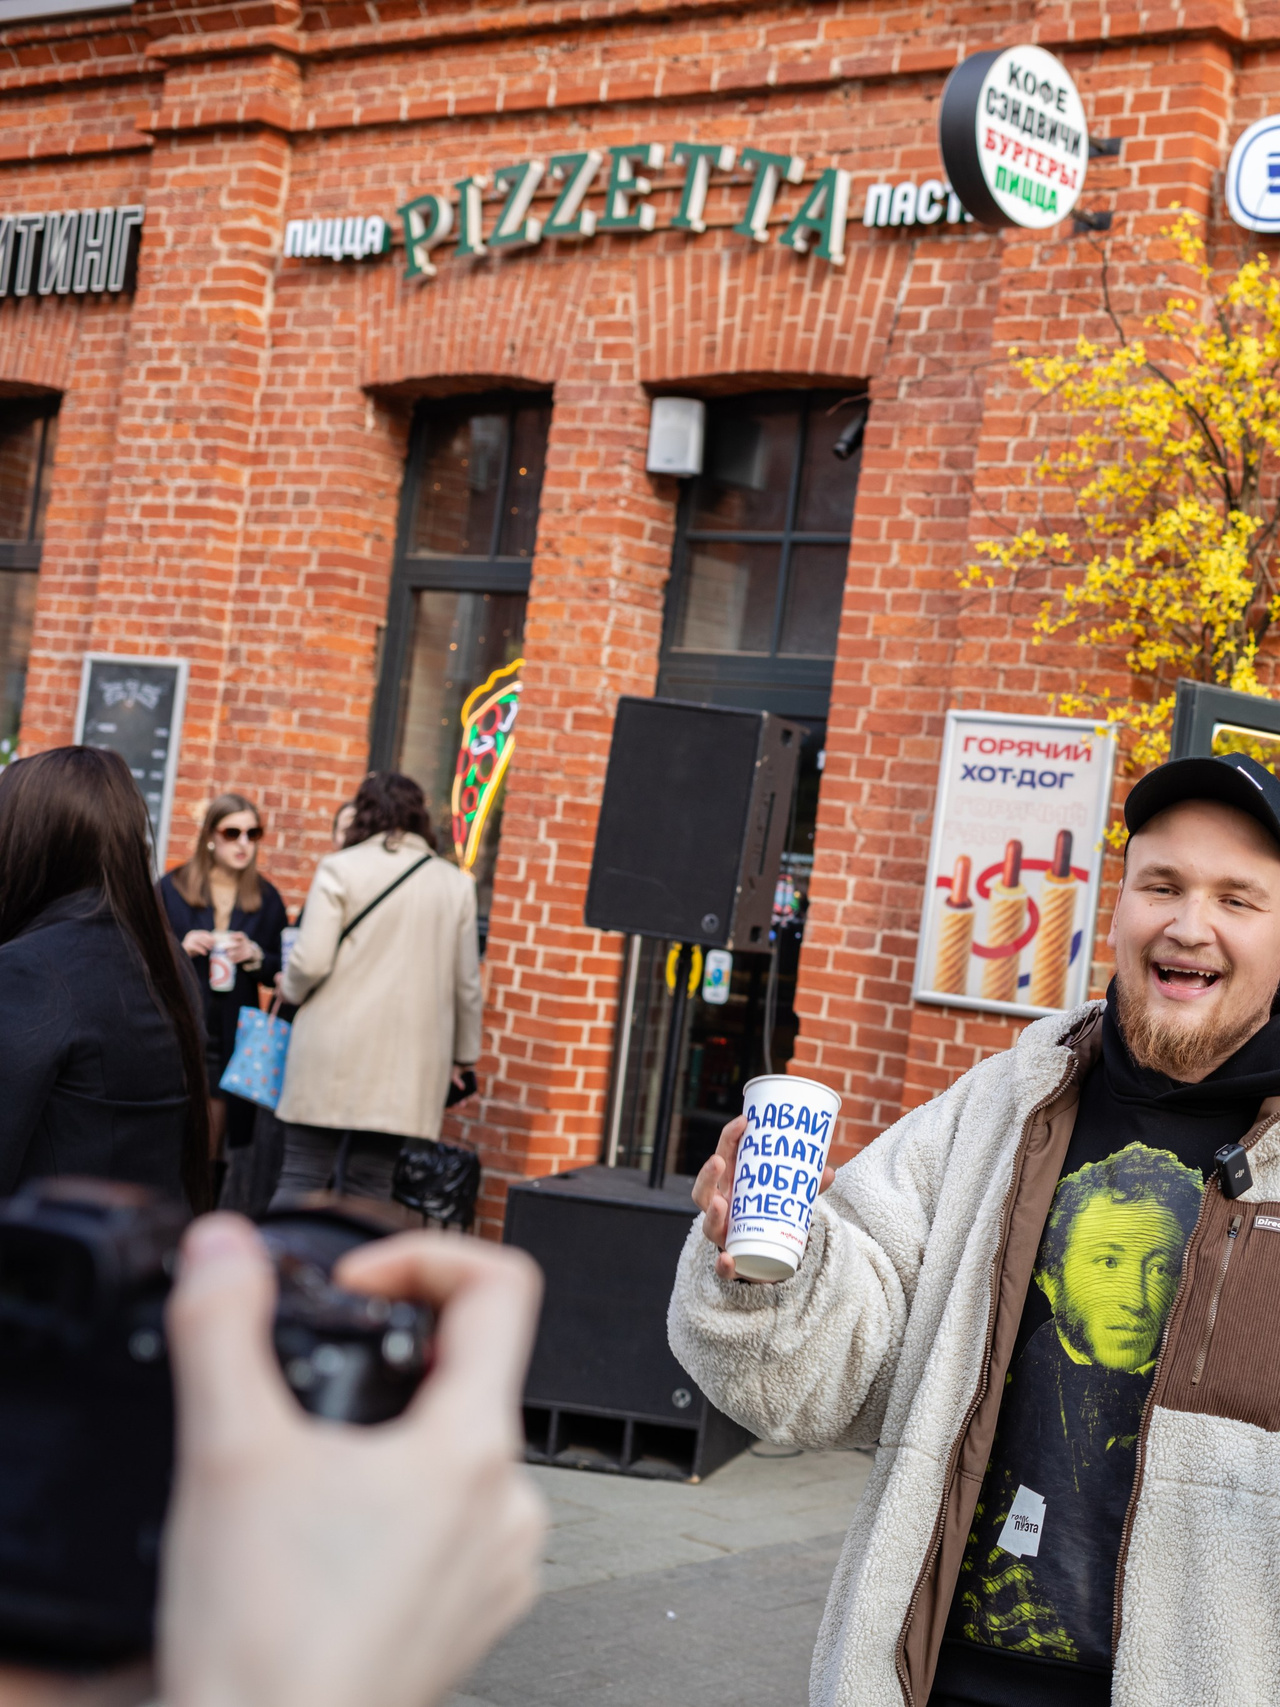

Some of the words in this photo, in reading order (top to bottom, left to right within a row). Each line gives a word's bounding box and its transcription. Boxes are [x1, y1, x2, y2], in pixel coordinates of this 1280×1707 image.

[1008, 61, 1068, 113] КОФЕ
[985, 86, 1082, 157] СЭНДВИЧИ
[985, 127, 1078, 190] БУРГЕРЫ
[397, 142, 851, 280] PIZZETTA
[863, 179, 975, 227] ПАСТ
[995, 164, 1058, 214] ПИЦЦА
[283, 215, 387, 262] ПИЦЦА
[963, 736, 1093, 763] ГОРЯЧИЙ
[960, 763, 1075, 789] ХОТ-ДОГ
[743, 1103, 832, 1144] ДАВАЙ
[739, 1134, 824, 1173] ДЕЛАТЬ
[734, 1162, 818, 1205] ДОБРО
[731, 1193, 813, 1233] ВМЕСТЕ
